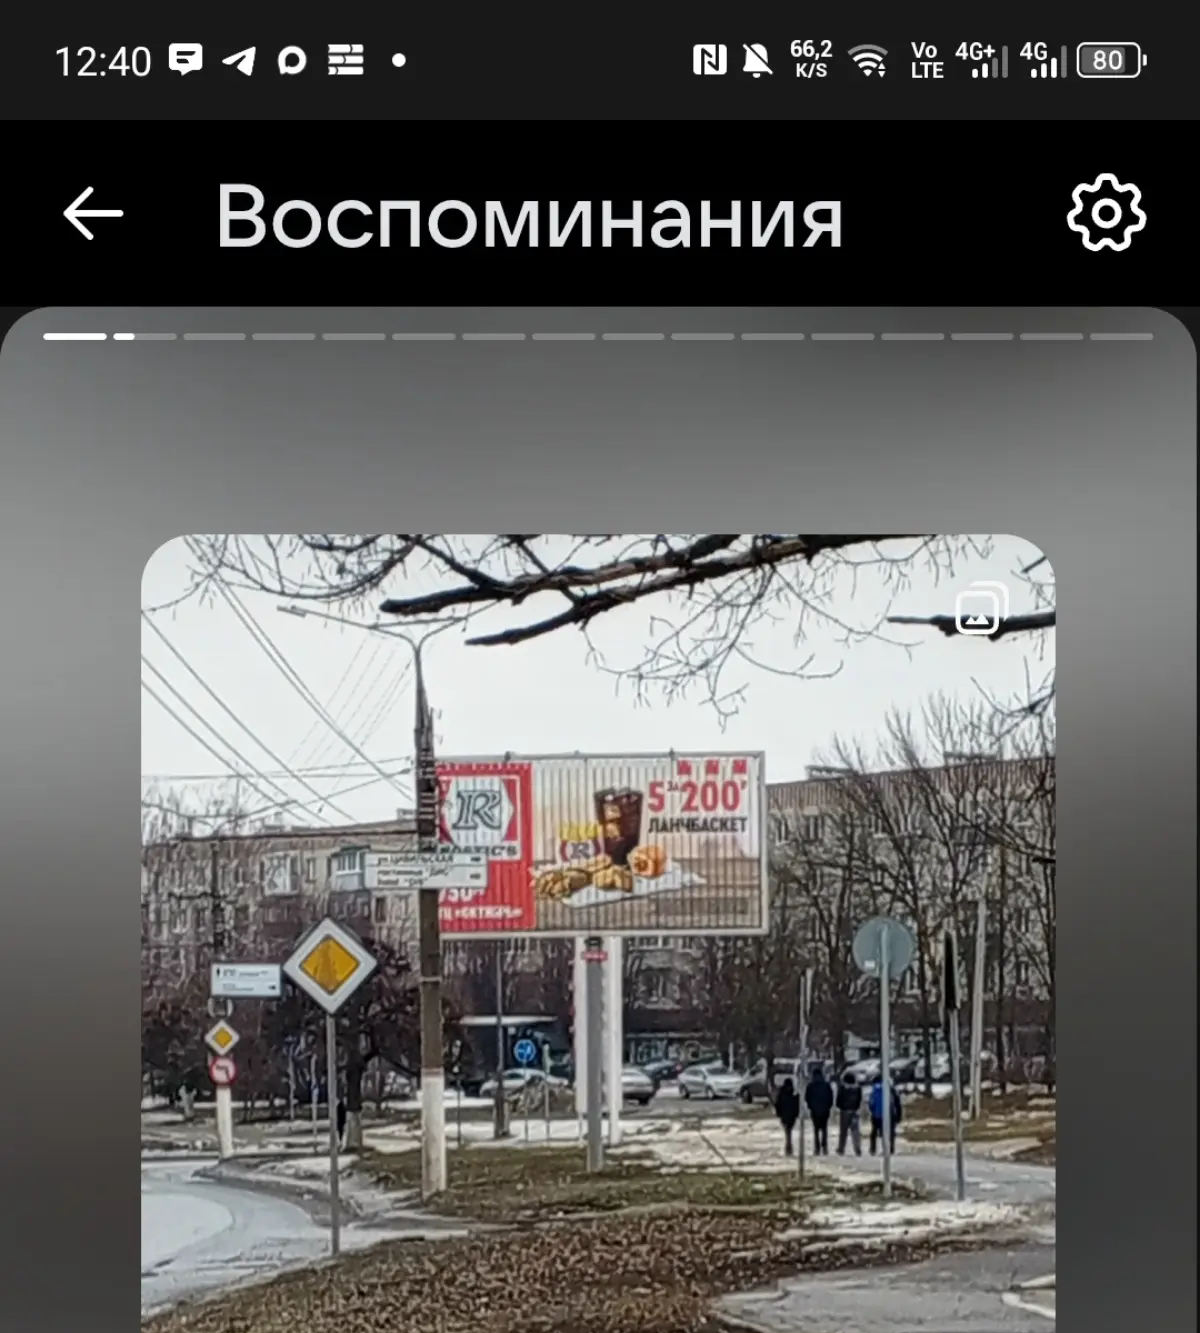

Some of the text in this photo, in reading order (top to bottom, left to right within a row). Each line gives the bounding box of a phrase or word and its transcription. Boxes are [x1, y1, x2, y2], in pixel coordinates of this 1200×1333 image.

[648, 781, 665, 813] 5
[680, 780, 740, 812] 200
[648, 817, 748, 833] ЛАНЧБАСКЕТ
